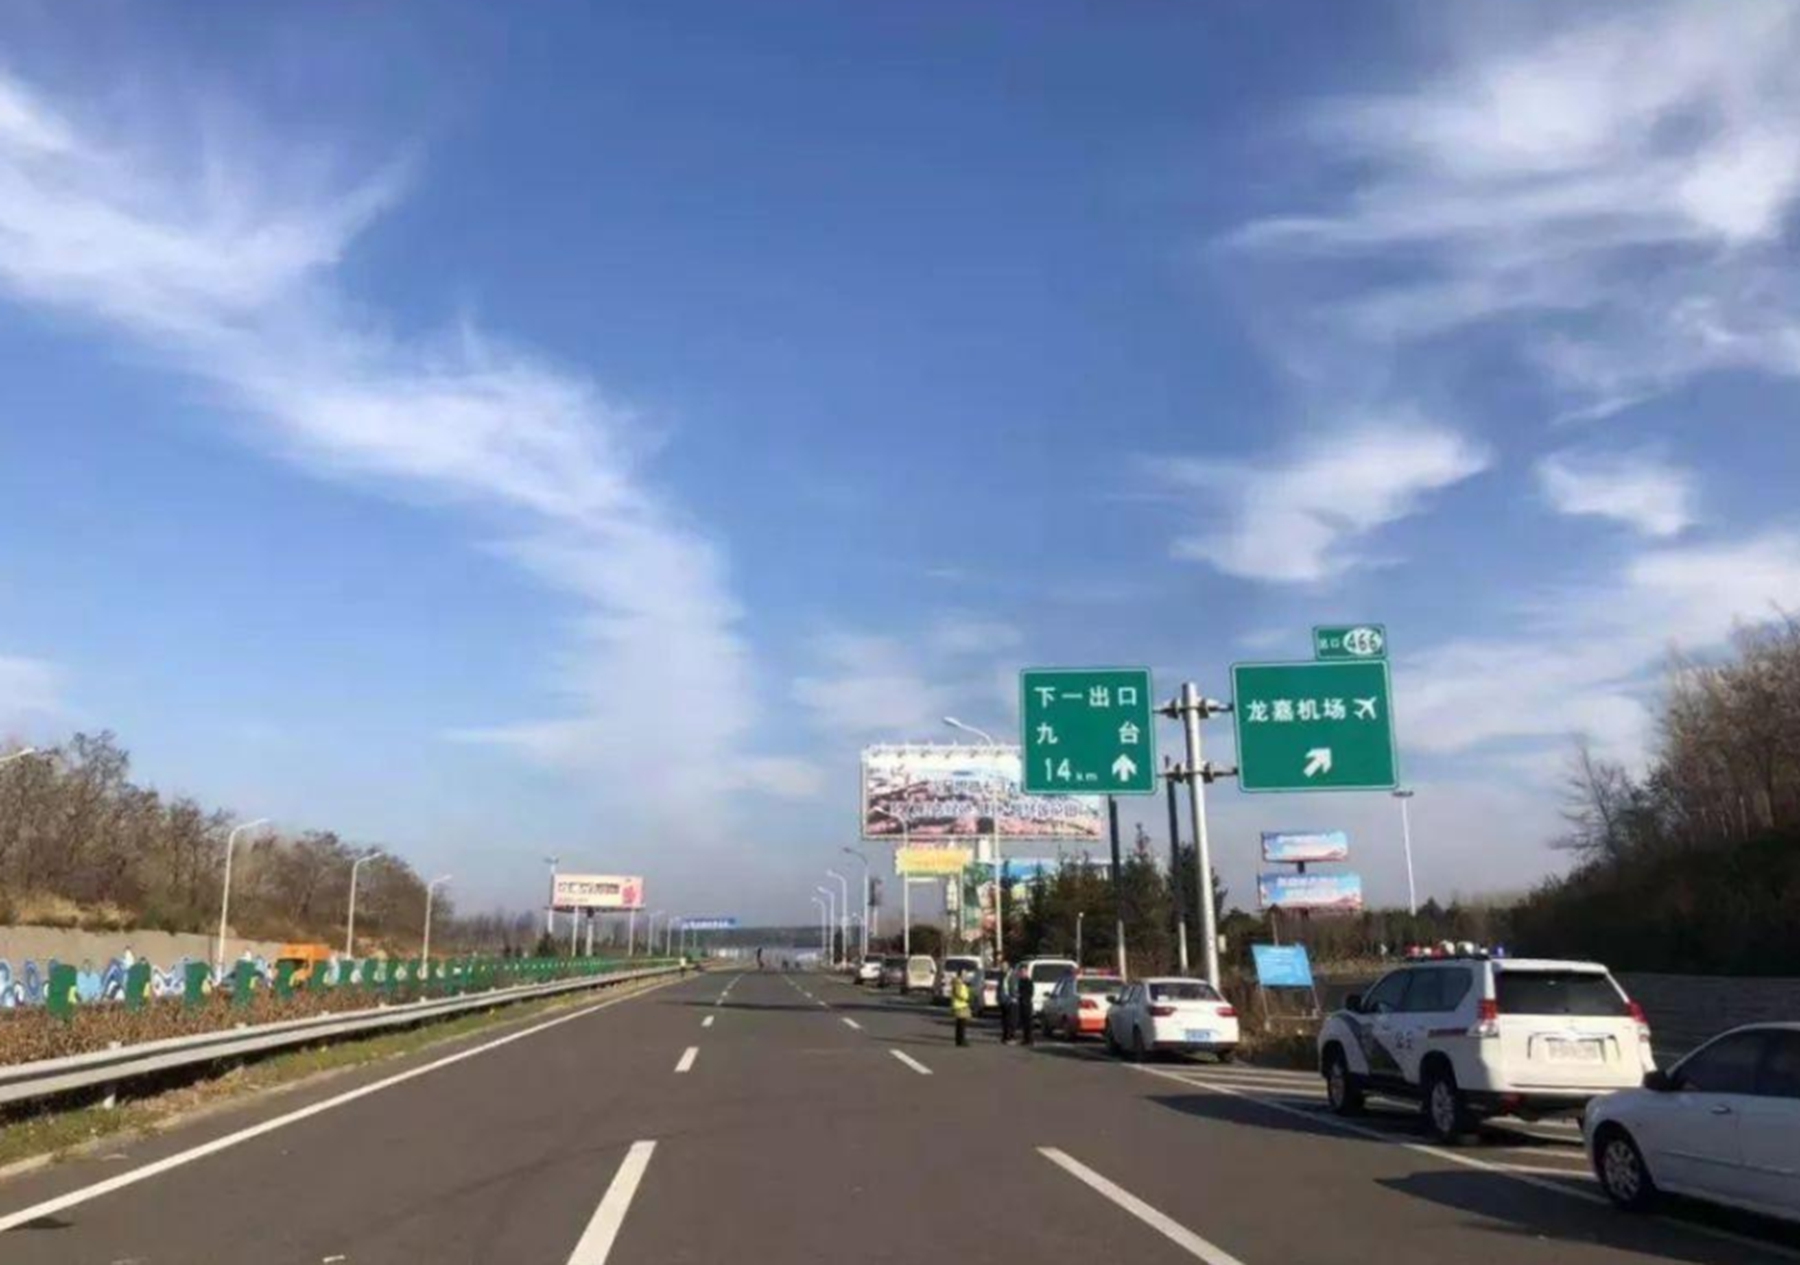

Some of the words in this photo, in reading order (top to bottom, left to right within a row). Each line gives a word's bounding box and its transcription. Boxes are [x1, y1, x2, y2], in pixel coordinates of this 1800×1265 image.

[1346, 632, 1378, 652] 466
[1034, 685, 1137, 709] 下一出口
[1246, 698, 1347, 722] 龙嘉机场
